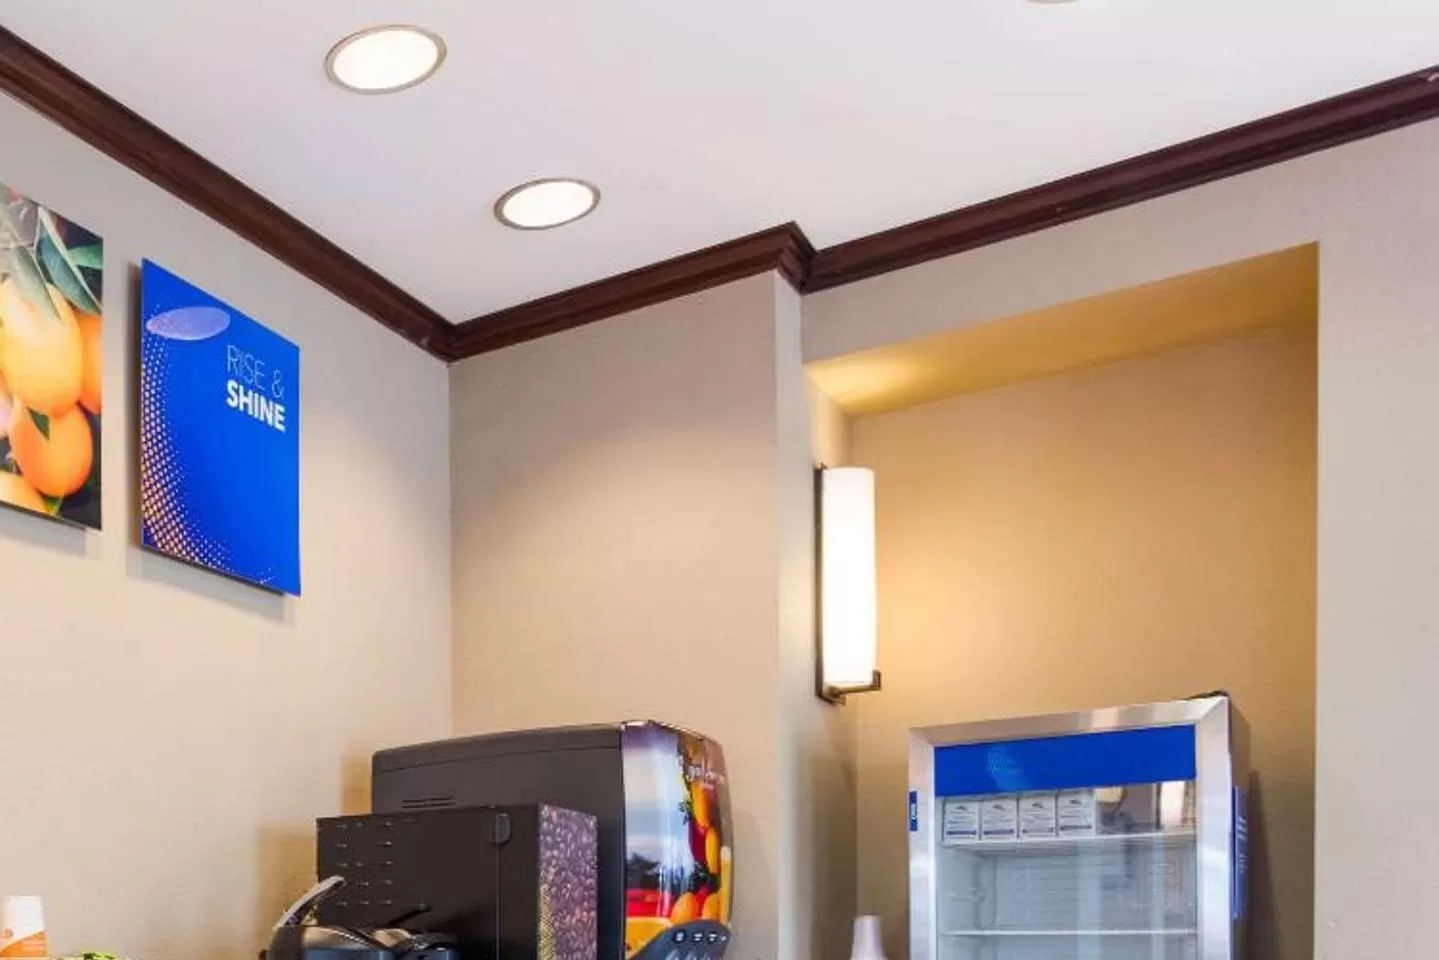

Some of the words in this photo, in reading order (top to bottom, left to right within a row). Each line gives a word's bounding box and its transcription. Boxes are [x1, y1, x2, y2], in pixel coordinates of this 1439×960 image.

[227, 344, 266, 391] RISE
[271, 368, 285, 400] &
[226, 379, 286, 433] SHINE
